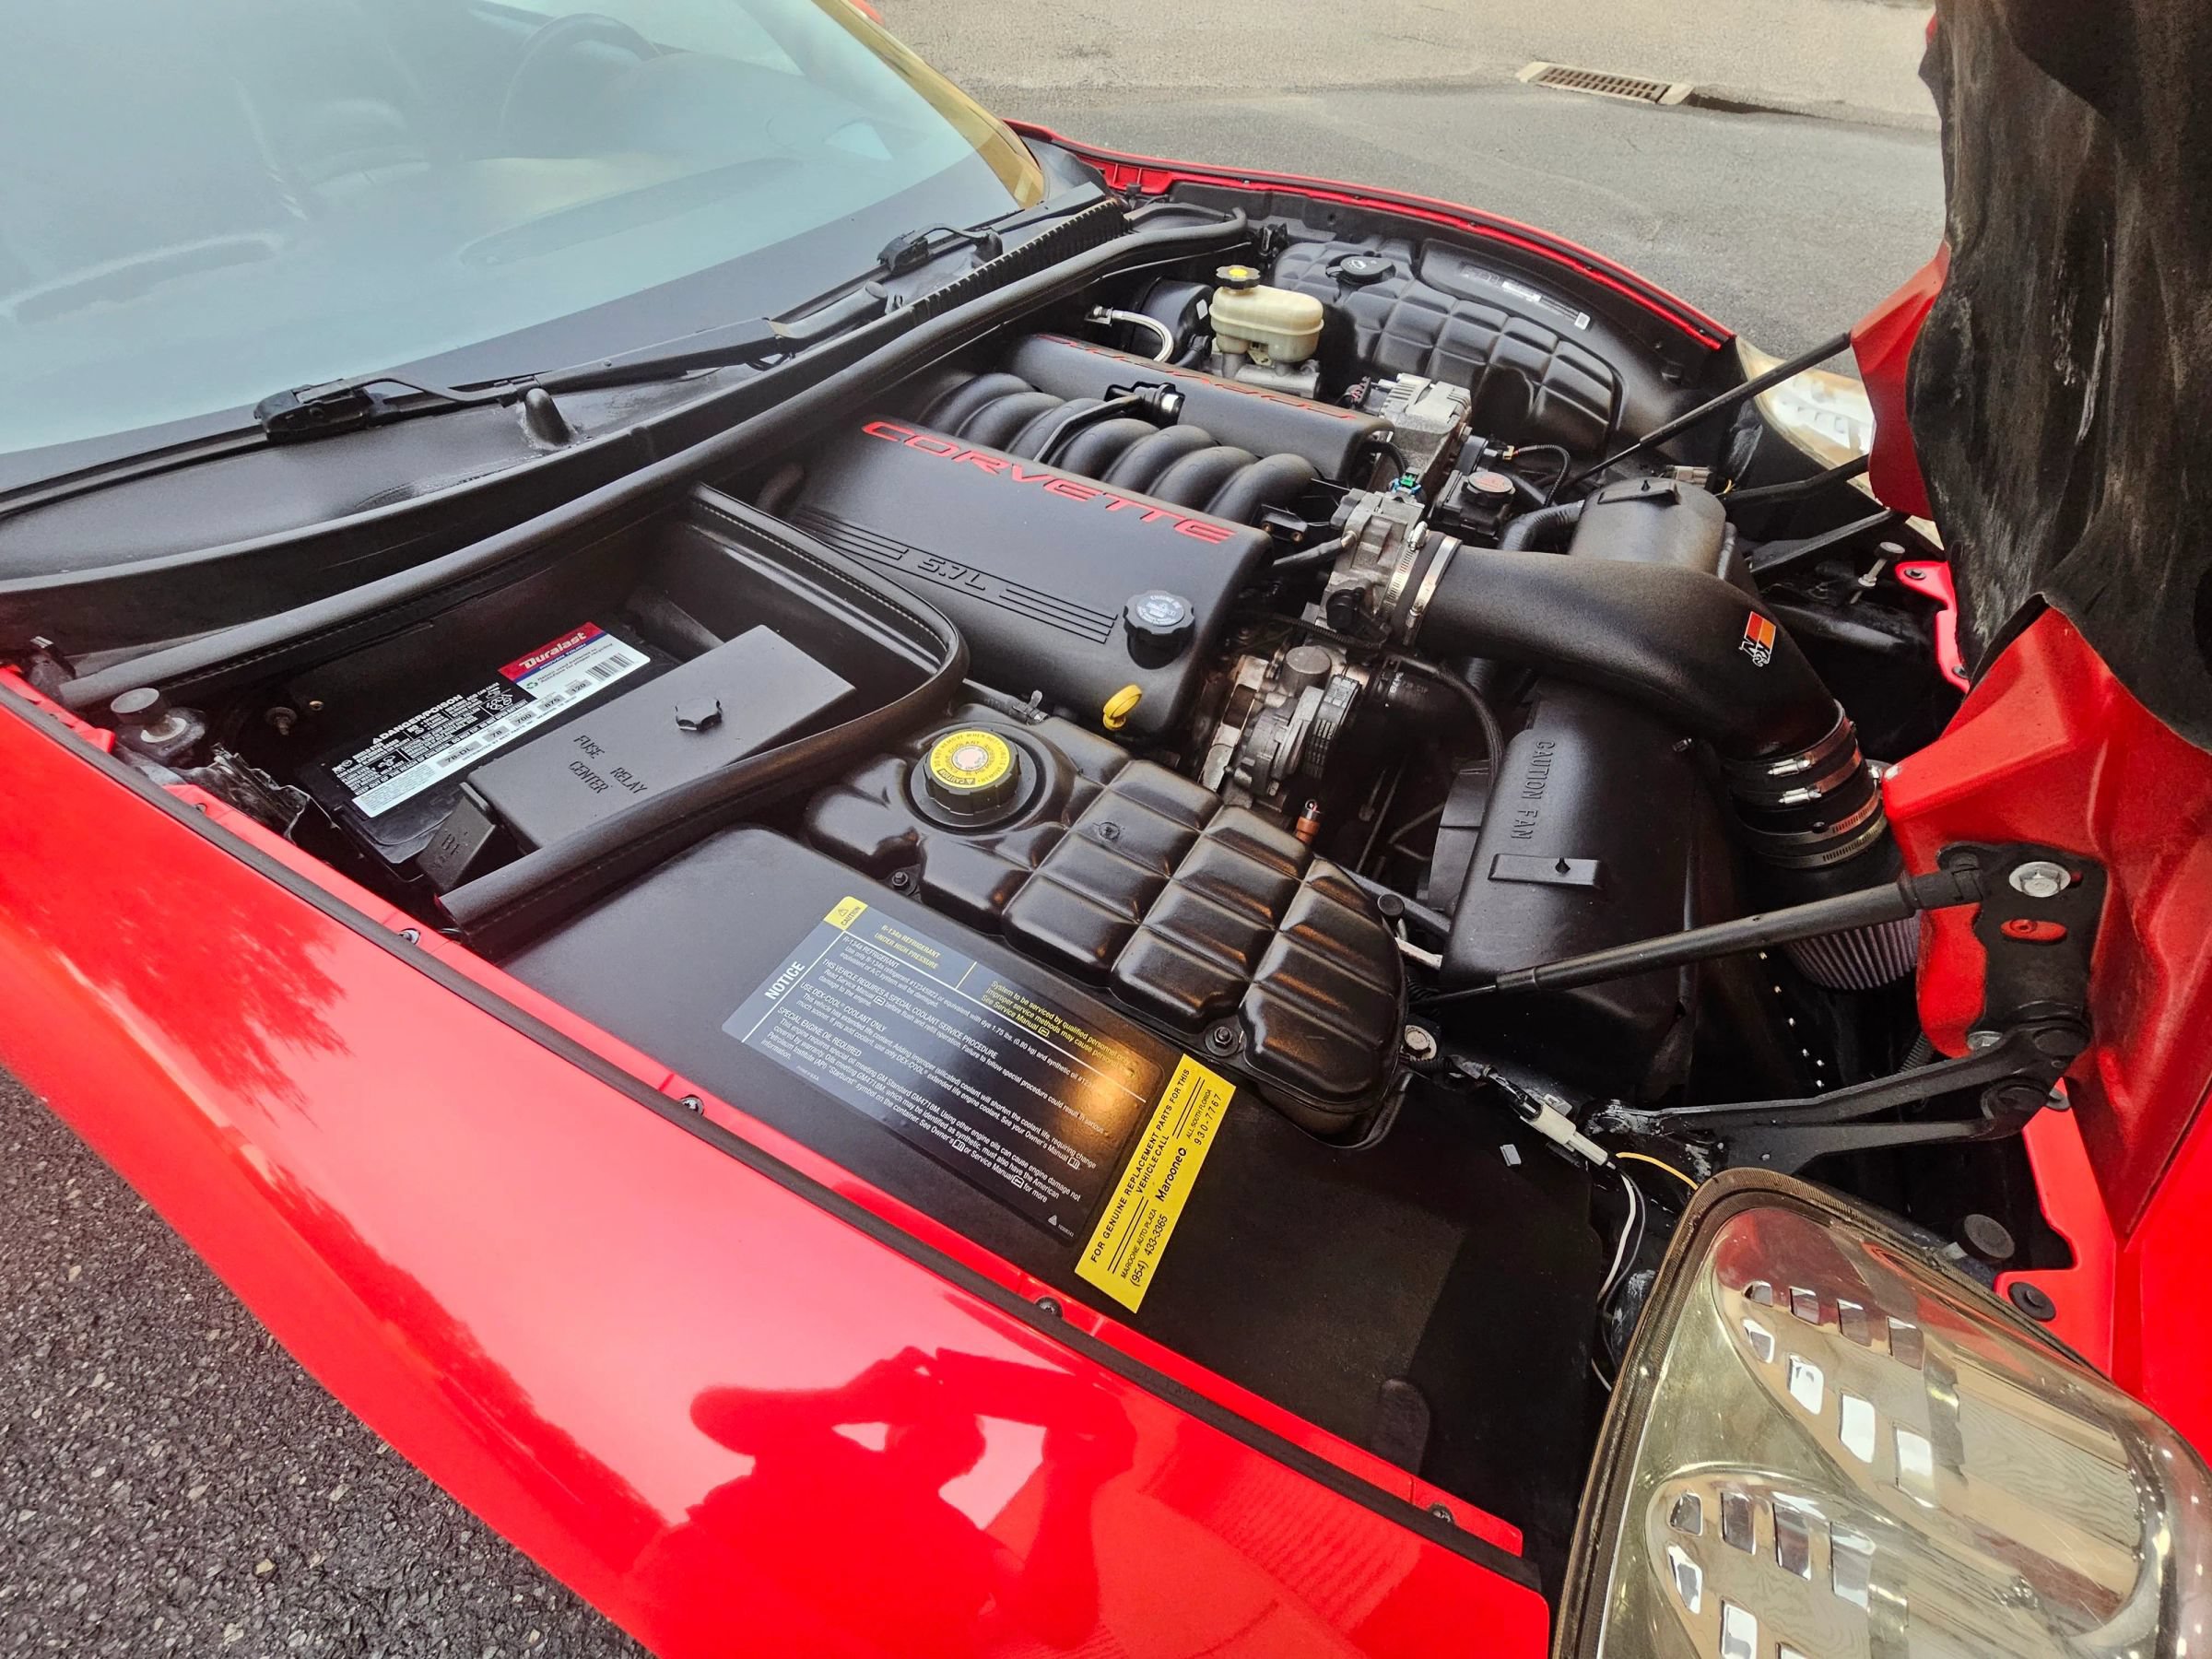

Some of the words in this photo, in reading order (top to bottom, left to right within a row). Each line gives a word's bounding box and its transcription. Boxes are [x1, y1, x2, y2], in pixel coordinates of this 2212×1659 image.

[862, 421, 1237, 545] CORVETTE
[918, 558, 986, 590] 5.7L
[519, 631, 587, 669] Duralast
[379, 694, 463, 740] DANGER/POISON
[444, 746, 474, 762] 78-DL
[490, 729, 502, 737] 78
[514, 713, 533, 724] 700
[570, 682, 588, 693] 120
[368, 780, 381, 788] OUT
[568, 760, 609, 794] CENTER
[573, 735, 605, 759] FUSE
[609, 767, 648, 794] RELAY
[939, 770, 965, 784] CAUTION
[1522, 741, 1556, 800] CAUTION
[1512, 810, 1538, 840] FAN
[840, 905, 861, 926] CAUTION
[880, 924, 902, 938] R-134a
[900, 935, 940, 959] REFRIGERANT
[874, 931, 895, 946] UNDER
[892, 942, 910, 954] HIGH
[907, 949, 938, 970] PRESSURE
[763, 960, 806, 1001] NOTICE
[799, 981, 814, 992] USE
[842, 1005, 872, 1024] COOLANT
[868, 1019, 887, 1032] ONLY
[777, 1006, 803, 1023] SPECIAL
[799, 1018, 824, 1035] ENGINE
[820, 1030, 834, 1041] OIL
[830, 1036, 862, 1057] REQUIRED
[821, 958, 837, 969] THIS
[833, 964, 859, 981] VEHICLE
[855, 975, 886, 995] REQUIRES
[888, 993, 913, 1010] SPECIAL
[911, 1006, 940, 1025] COOLANT
[937, 1020, 964, 1039] SERVICE
[960, 1034, 998, 1059] PROCEDURE
[980, 994, 994, 1005] See
[993, 1001, 1016, 1018] Service
[1015, 1014, 1039, 1030] Manual
[985, 987, 1013, 1006] Improper
[1012, 1003, 1034, 1018] service
[1034, 1016, 1060, 1033] methods
[1060, 1030, 1074, 1042] may
[1073, 1039, 1092, 1053] cause
[991, 980, 1013, 996] System
[1028, 1002, 1054, 1019] serviced
[1061, 1021, 1088, 1039] qualified
[1086, 1037, 1117, 1056] personnel
[892, 1042, 912, 1058] Adding
[910, 1053, 935, 1070] improper
[933, 1065, 961, 1087] (silicated)
[959, 1082, 982, 1098] coolant
[979, 1094, 992, 1103] will
[989, 1100, 1011, 1116] shorten
[1010, 1111, 1020, 1122] the
[1019, 1118, 1041, 1135] coolant
[1040, 1129, 1050, 1142] life,
[1050, 1137, 1076, 1158] requiring
[1075, 1153, 1096, 1169] change
[925, 1074, 953, 1090] extended
[950, 1086, 960, 1096] life
[959, 1093, 979, 1107] engine
[978, 1104, 1000, 1120] coolant.
[999, 1115, 1012, 1127] See
[1010, 1124, 1025, 1135] your
[1024, 1130, 1047, 1148] Owner's
[1046, 1144, 1068, 1161] Manual
[1185, 1126, 1194, 1138] ALL
[1190, 1108, 1203, 1128] SOUTH
[1198, 1088, 1212, 1111] FLORIDA
[1193, 1092, 1222, 1146] 930-7767
[885, 1078, 912, 1097] Standard
[939, 1109, 957, 1125] Using
[955, 1120, 971, 1133] other
[970, 1129, 990, 1145] engine
[989, 1141, 1000, 1151] oils
[999, 1147, 1011, 1158] can
[1010, 1154, 1029, 1169] cause
[1028, 1165, 1048, 1181] engine
[1046, 1175, 1070, 1194] damage
[1069, 1191, 1081, 1201] not
[885, 1089, 904, 1102] which
[901, 1099, 915, 1111] may
[922, 1110, 949, 1129] identified
[954, 1131, 981, 1152] synthetic,
[981, 1147, 997, 1159] must
[995, 1156, 1009, 1167] also
[1007, 1162, 1023, 1176] have
[1021, 1171, 1033, 1182] the
[1031, 1177, 1059, 1199] American
[918, 1119, 931, 1130] See
[929, 1125, 954, 1145] Owner's
[970, 1149, 992, 1168] Service
[991, 1163, 1014, 1182] Manual
[1022, 1182, 1032, 1193] for
[1030, 1189, 1047, 1203] more
[1089, 1241, 1105, 1263] FOR
[1101, 1195, 1127, 1240] GENUINE
[1124, 1131, 1159, 1195] REPLACEMENT
[1155, 1103, 1172, 1131] PARTS
[1169, 1086, 1181, 1103] FOR
[1177, 1067, 1190, 1087] THIS
[1135, 1155, 1159, 1194] VEHICLE
[1154, 1132, 1170, 1157] CALL
[1155, 1152, 1183, 1202] Maroone
[1120, 1244, 1140, 1279] MAROONE
[1135, 1227, 1148, 1246] AUTO
[1143, 1206, 1157, 1229] PLAZA
[1129, 1258, 1148, 1288] (954)
[1143, 1213, 1168, 1257] 433-3365
